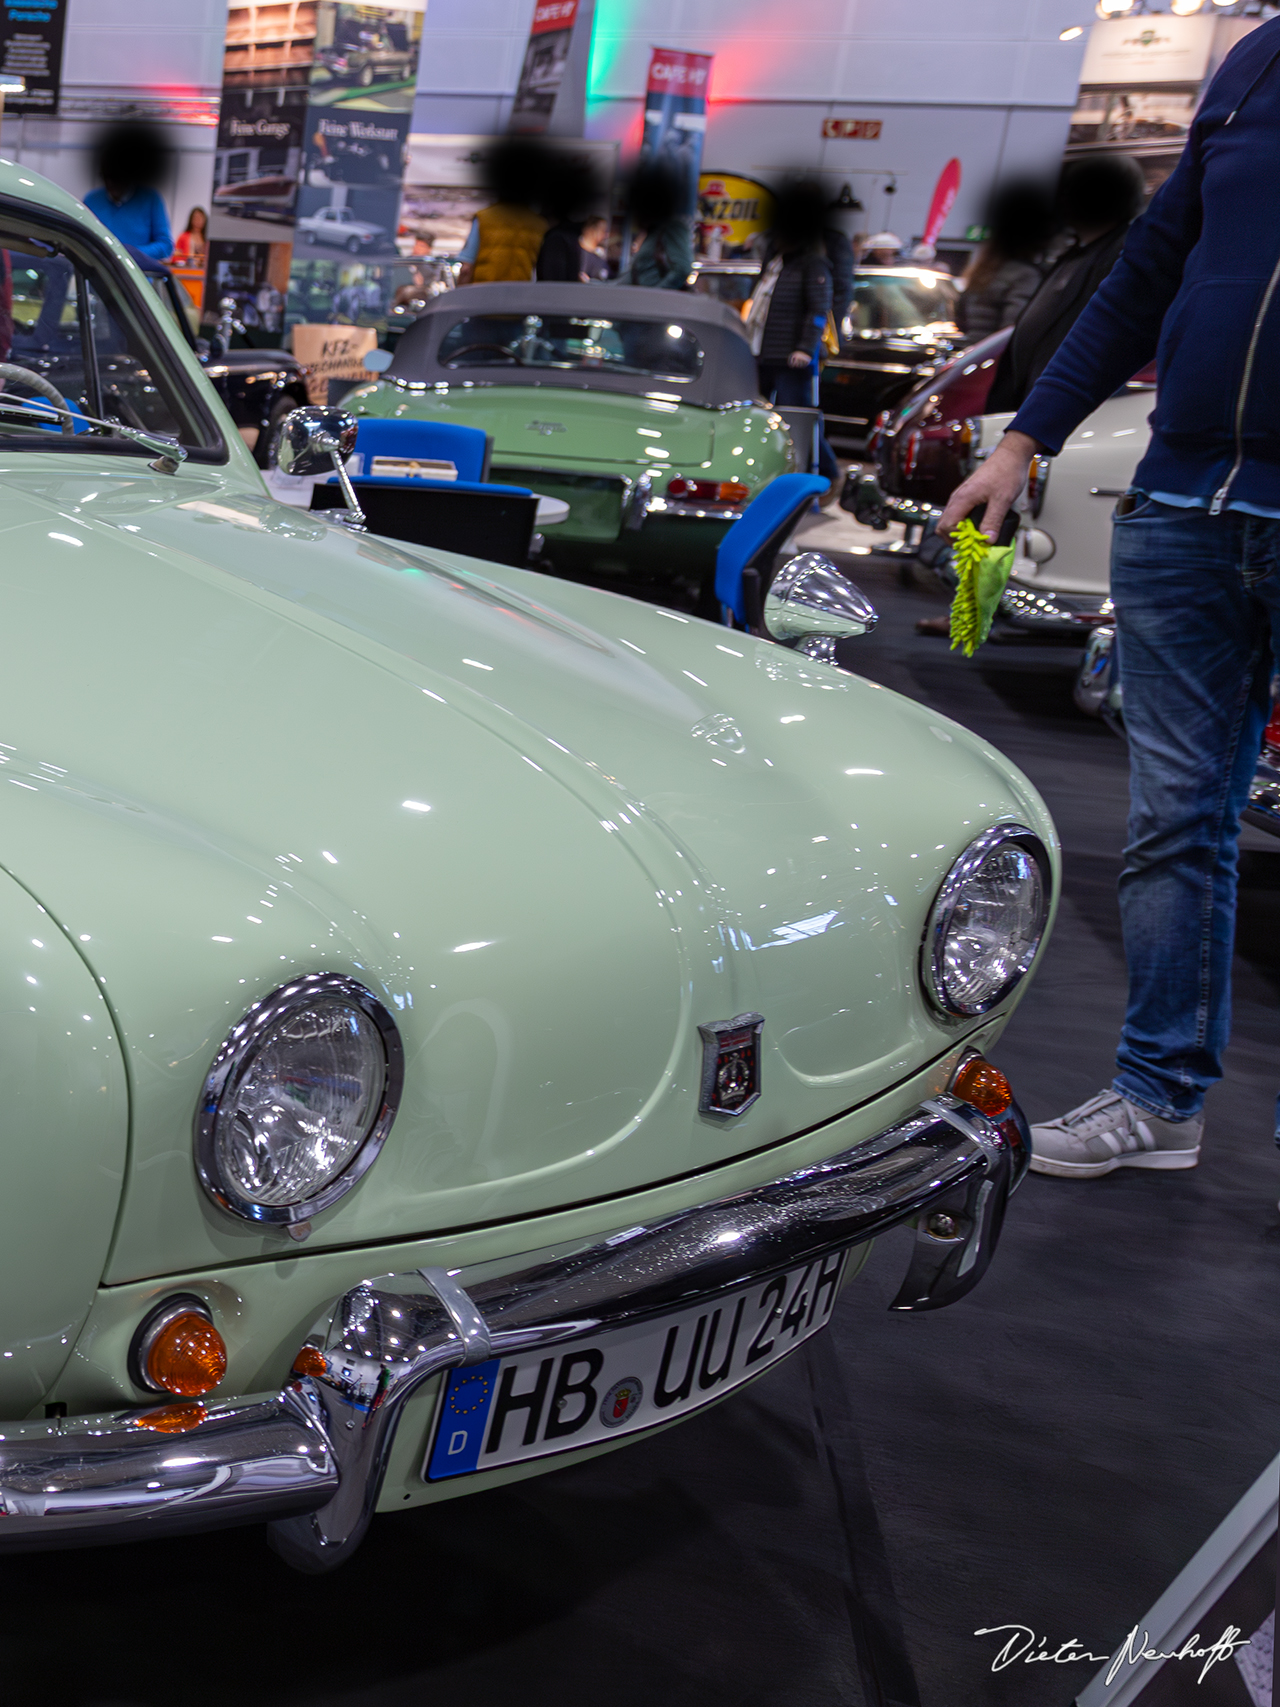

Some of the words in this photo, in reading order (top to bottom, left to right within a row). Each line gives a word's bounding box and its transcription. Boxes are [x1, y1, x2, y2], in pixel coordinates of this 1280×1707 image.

[485, 1348, 604, 1454] HB
[653, 1297, 747, 1408] UU
[746, 1250, 846, 1367] 24H
[447, 1430, 468, 1456] D
